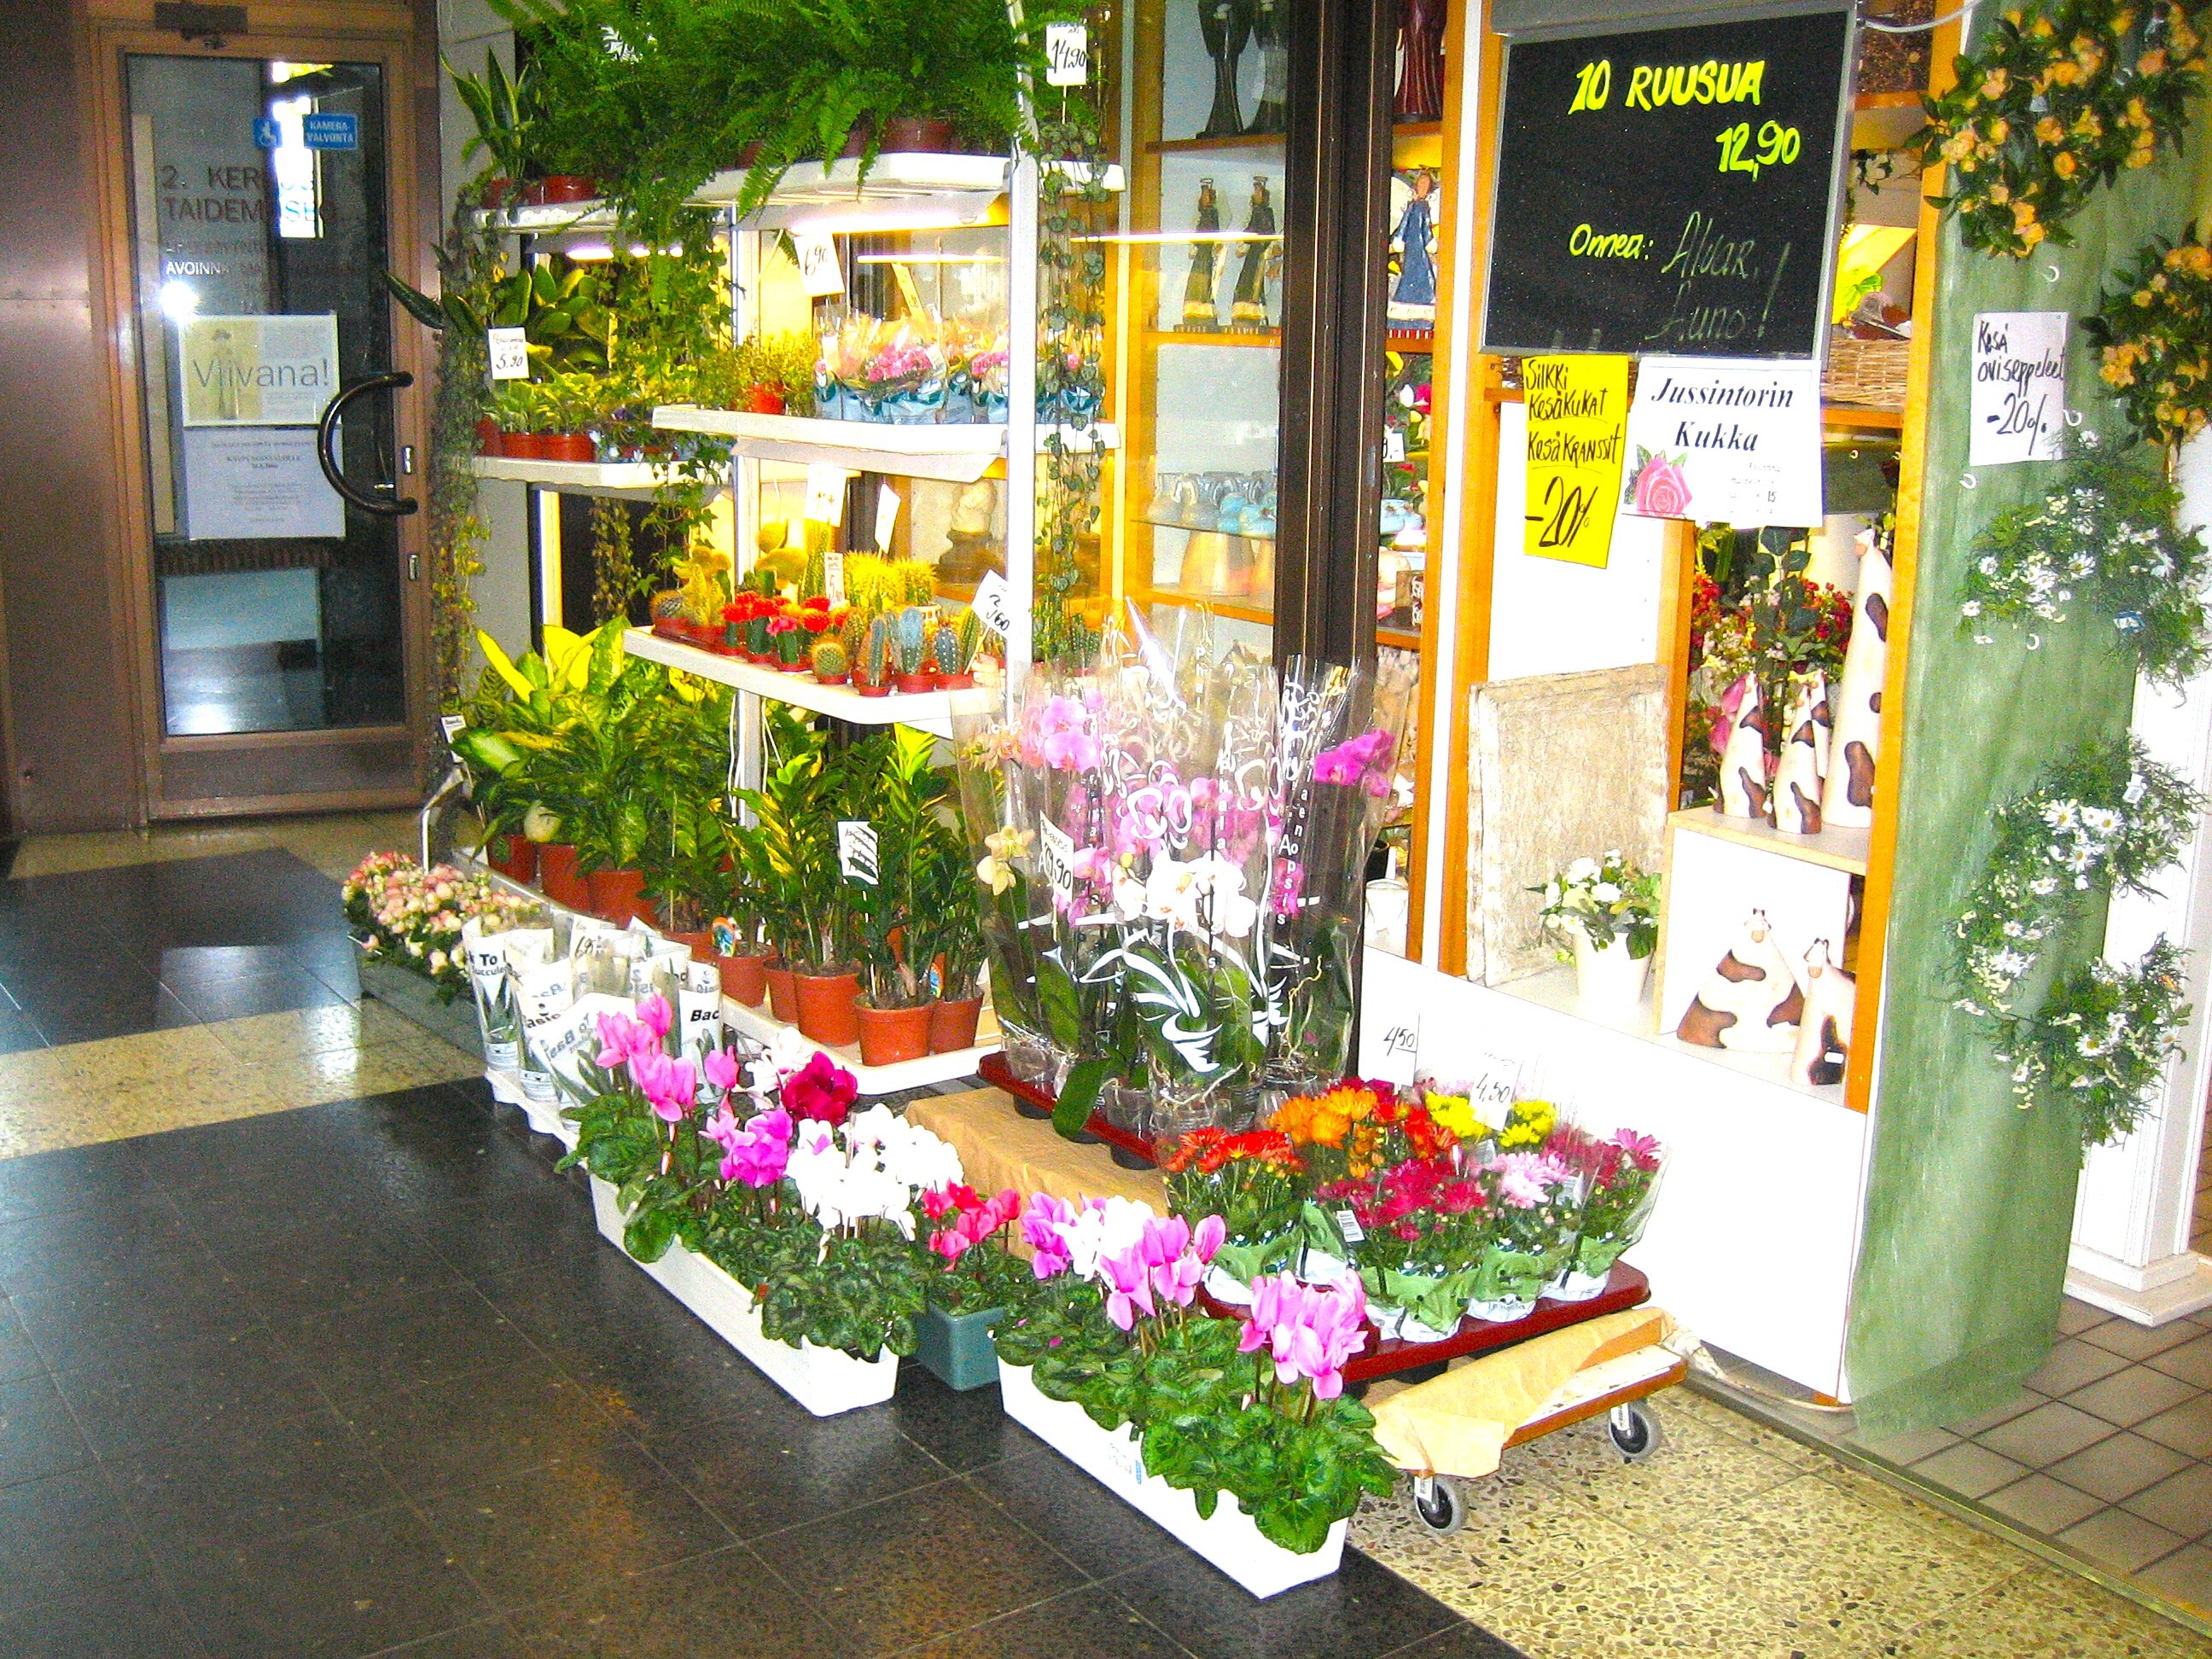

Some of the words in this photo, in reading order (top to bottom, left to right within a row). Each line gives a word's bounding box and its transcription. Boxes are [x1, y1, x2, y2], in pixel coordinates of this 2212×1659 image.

[1569, 59, 1611, 114] 10
[1625, 60, 1766, 112] RUUSUA
[1715, 120, 1801, 182] 12,90
[163, 199, 337, 223] TAIDEMSEO
[1526, 359, 1569, 391] Silkki
[1651, 377, 1794, 408] Jussintorin
[1674, 421, 1759, 451] Kukka
[1987, 393, 2047, 457] -20%
[1525, 475, 1598, 548] -20%
[480, 953, 498, 966] To
